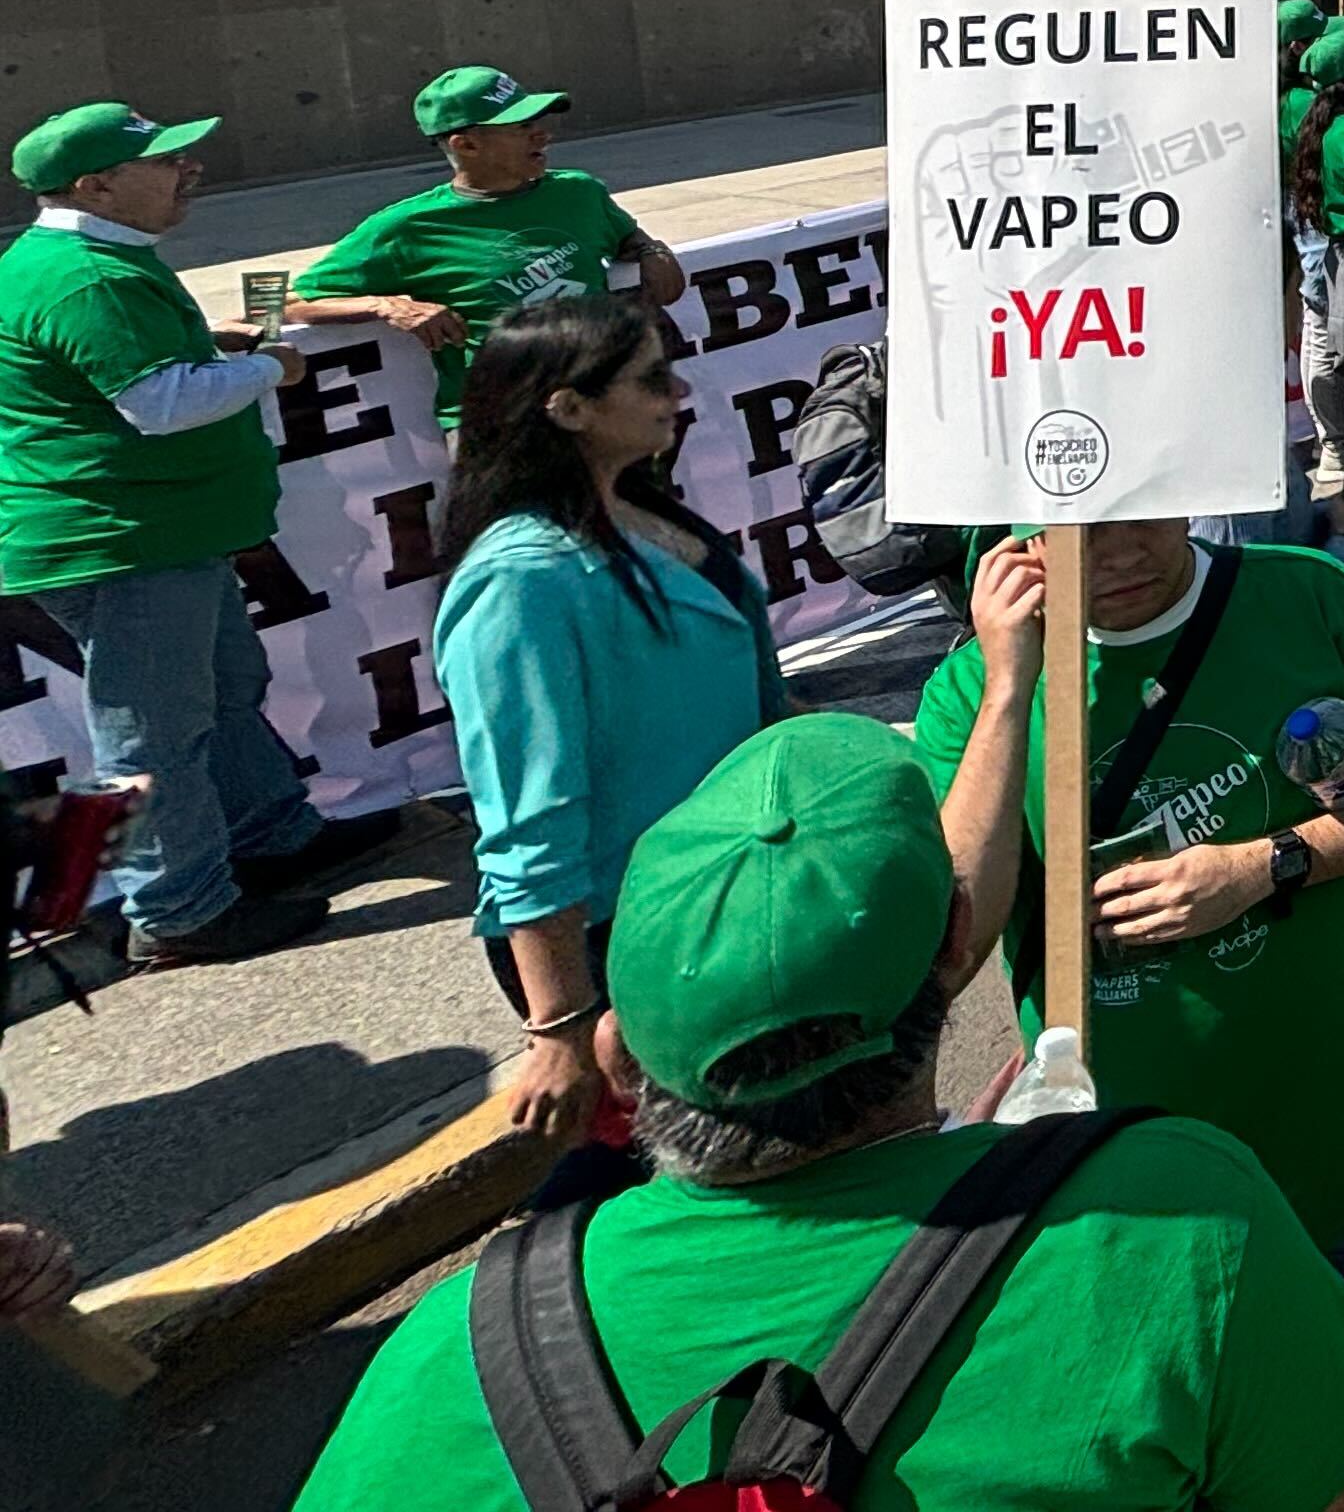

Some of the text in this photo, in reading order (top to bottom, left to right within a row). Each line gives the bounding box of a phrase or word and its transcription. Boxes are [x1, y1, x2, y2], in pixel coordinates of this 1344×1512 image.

[920, 6, 1236, 69] REGULEN
[1026, 103, 1099, 156] EL
[946, 192, 1181, 251] VAPEO
[990, 286, 1145, 378] ¡YA!
[1094, 973, 1139, 989] VAPERS
[1094, 987, 1140, 1002] ALLIANCE
